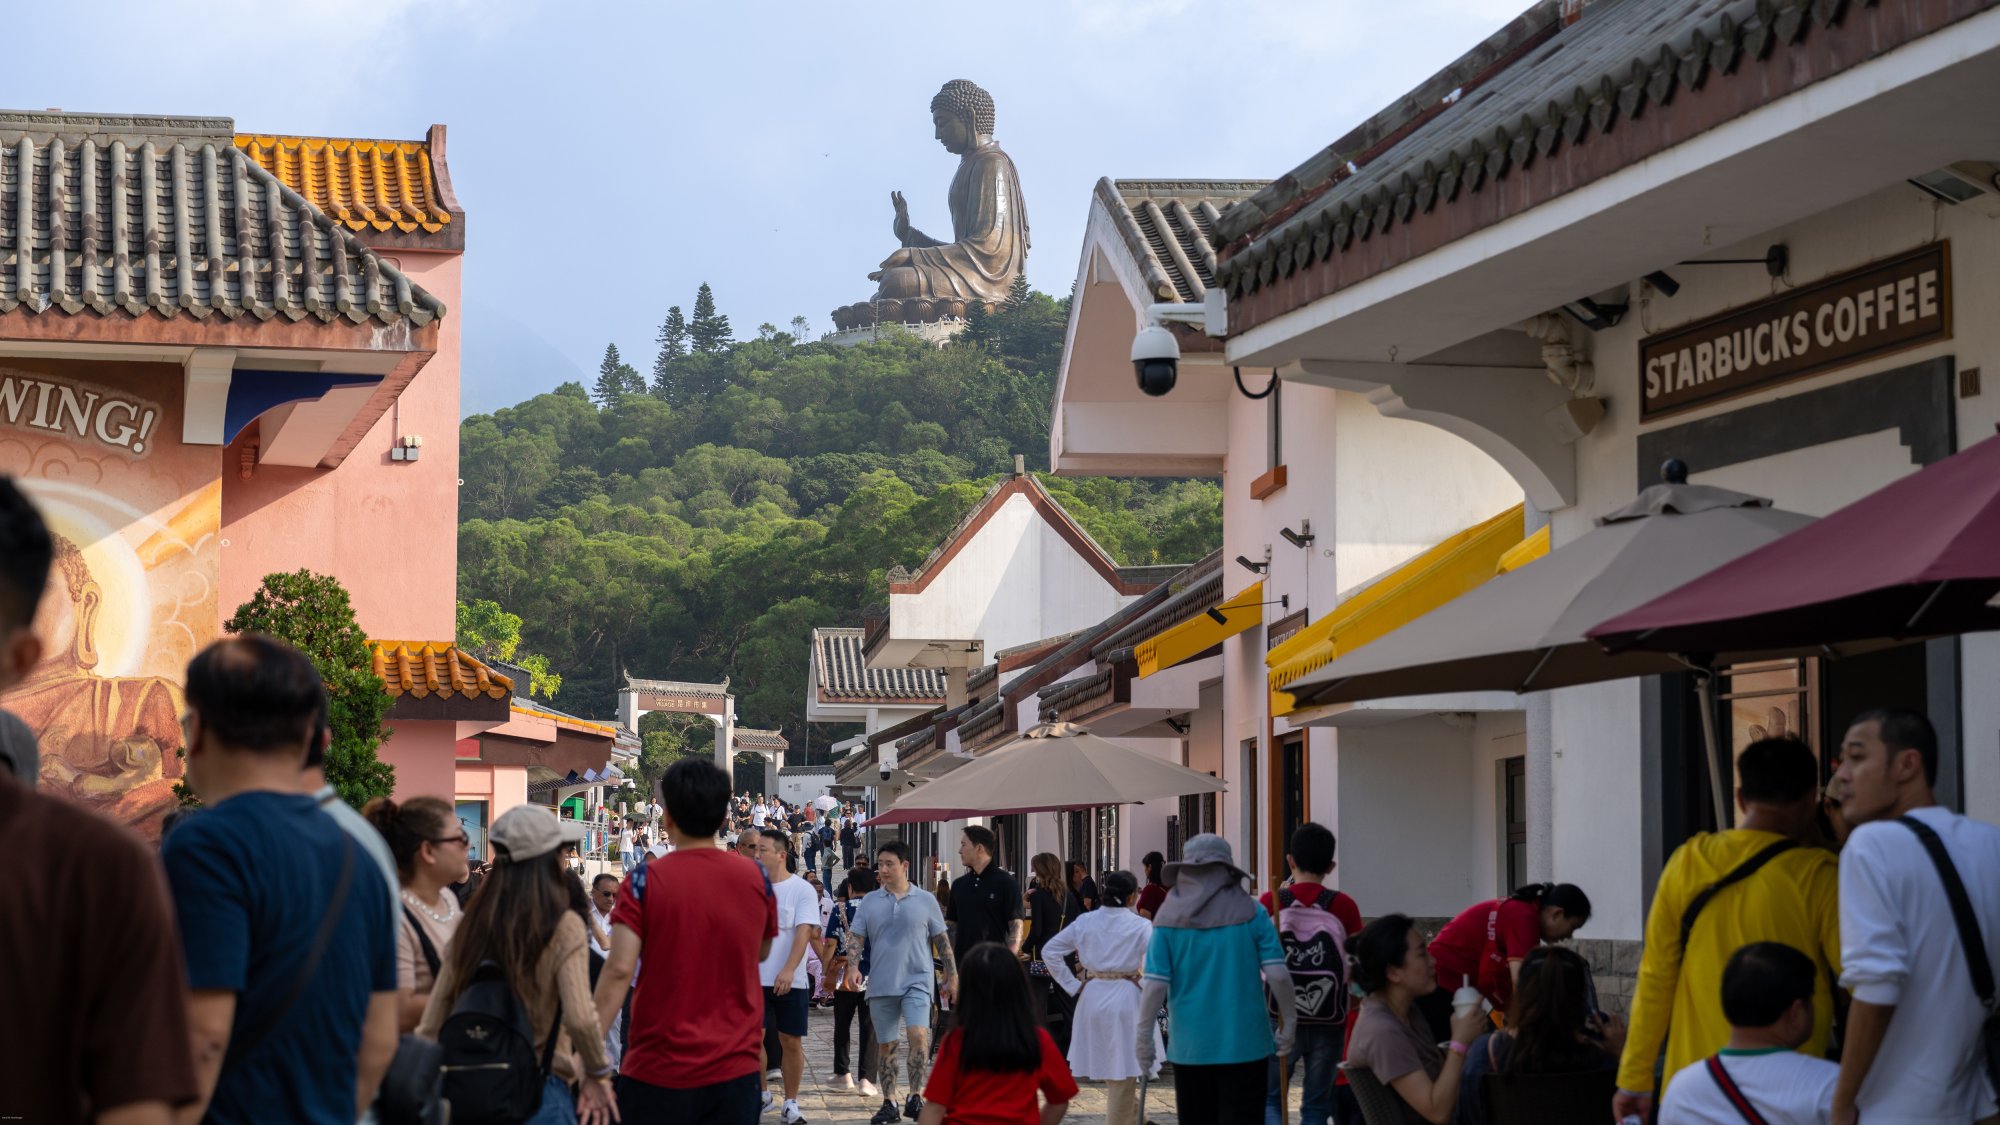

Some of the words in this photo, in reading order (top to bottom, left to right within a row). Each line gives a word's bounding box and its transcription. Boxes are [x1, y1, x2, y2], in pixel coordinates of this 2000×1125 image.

[1646, 310, 1810, 399] STARBUCKS
[1814, 269, 1938, 348] COFFEE
[1284, 939, 1326, 966] Roxy
